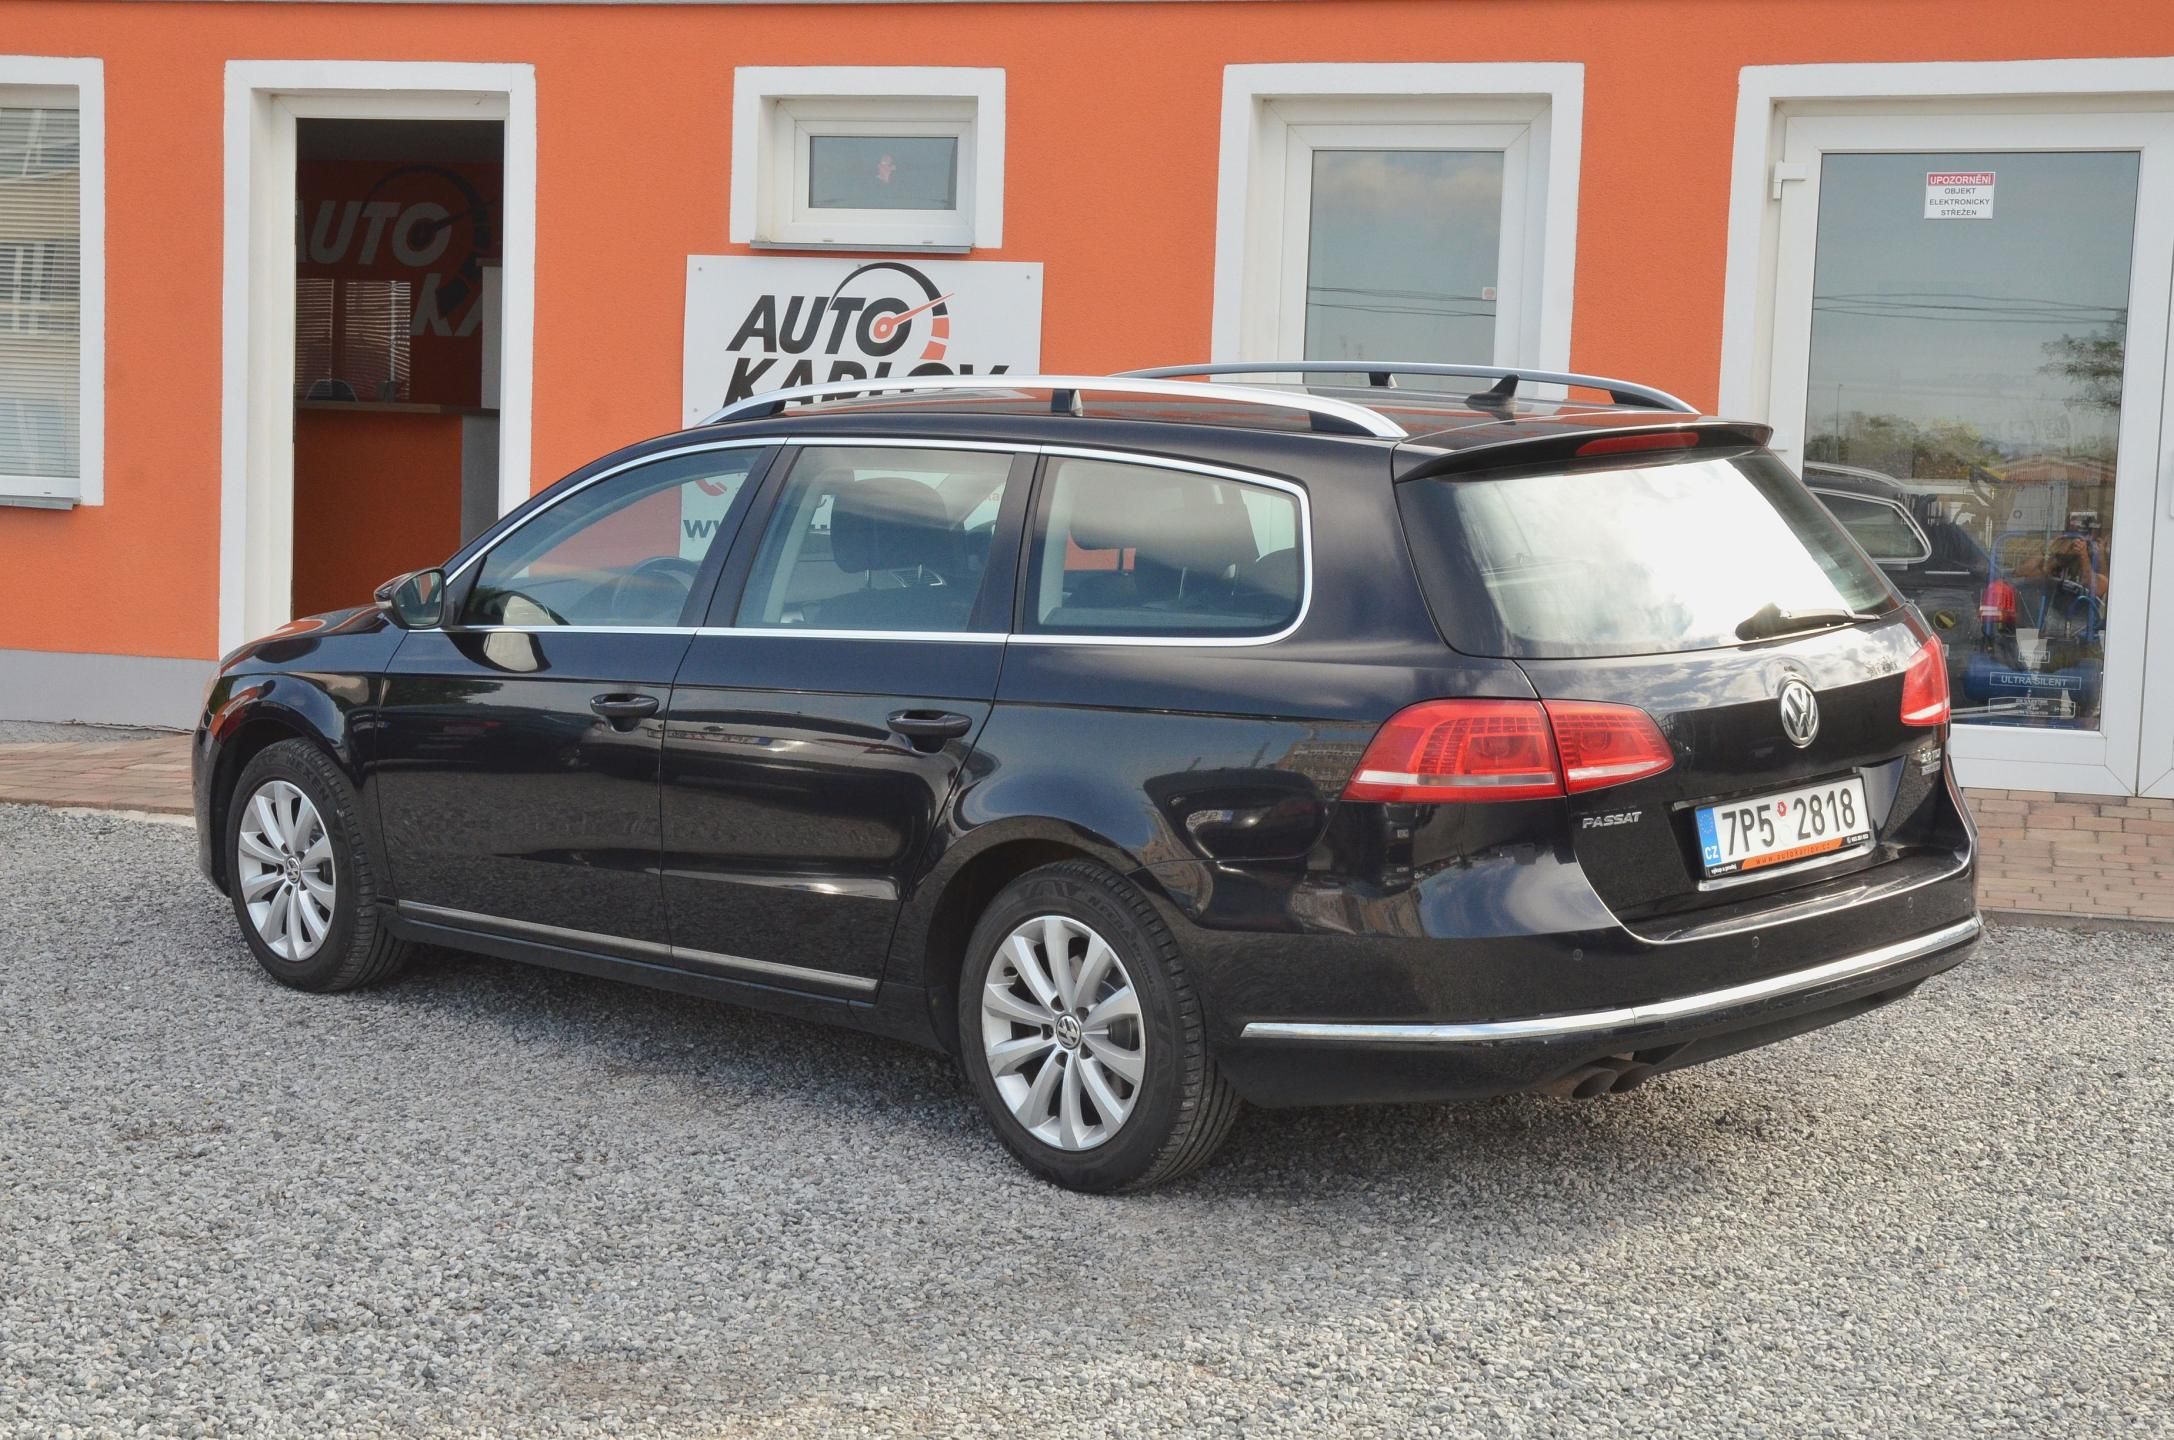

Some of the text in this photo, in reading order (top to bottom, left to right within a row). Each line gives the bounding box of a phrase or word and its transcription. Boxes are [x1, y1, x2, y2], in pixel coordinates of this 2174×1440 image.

[1930, 174, 1991, 185] UPOZORNĚNÍ
[1944, 187, 1976, 195] OBJEKT
[1929, 198, 1990, 206] ELEKTRONICKY
[1941, 208, 1977, 216] STŘEŽEN
[726, 294, 912, 357] AUTO
[2000, 674, 2067, 687] ULTRA SILENT
[1582, 811, 1642, 829] PASSAT
[1721, 787, 1856, 856] 7P5 2818
[1705, 845, 1719, 860] CZ
